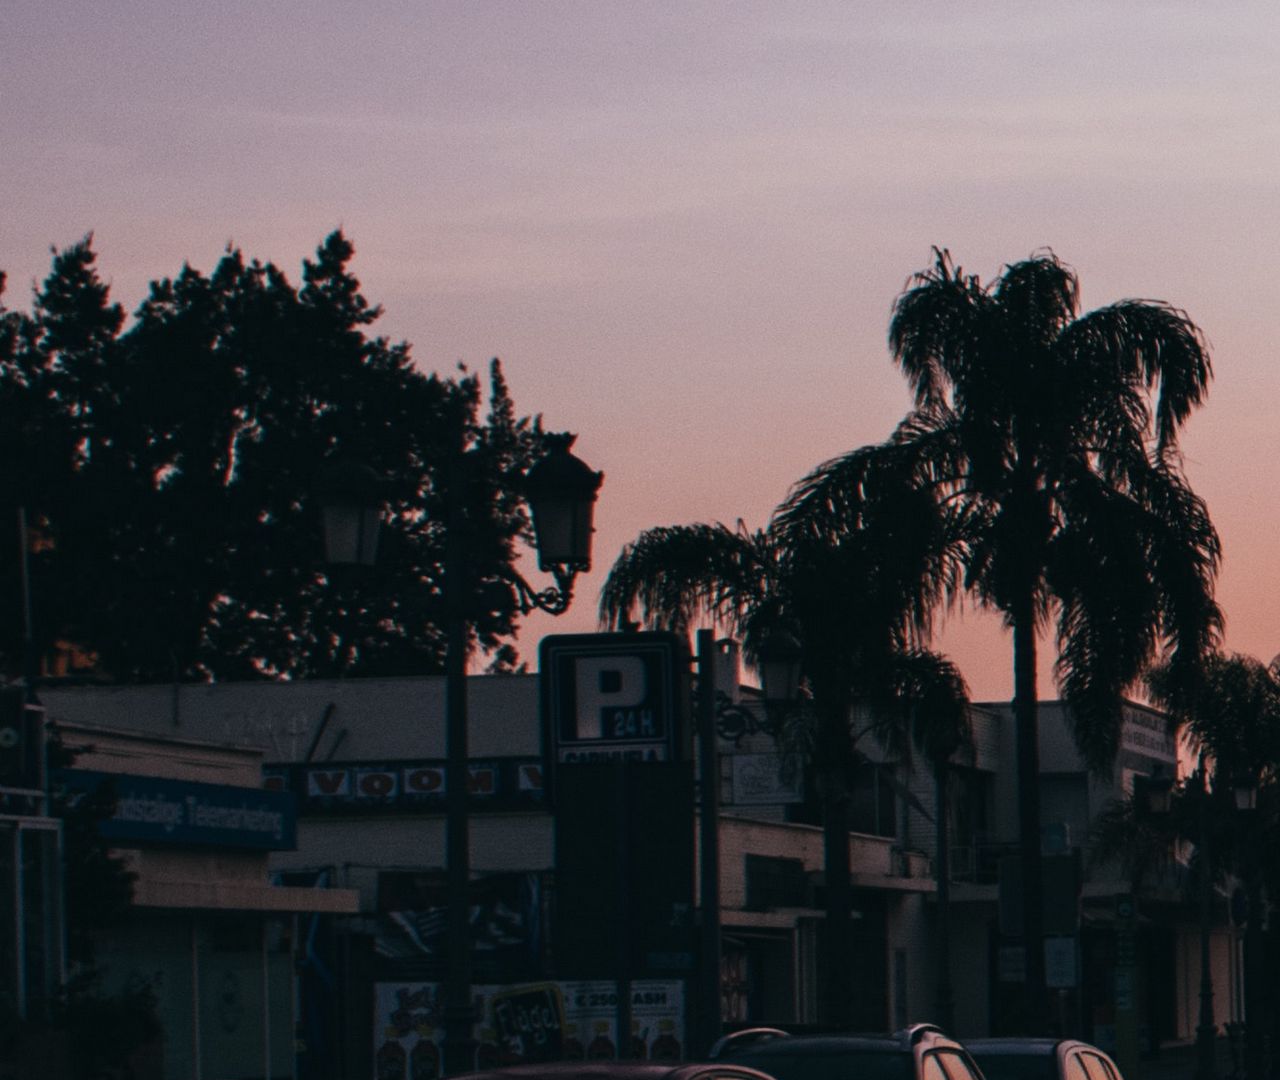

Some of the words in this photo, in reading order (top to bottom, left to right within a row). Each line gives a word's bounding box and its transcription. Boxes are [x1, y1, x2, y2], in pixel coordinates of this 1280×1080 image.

[576, 656, 647, 739] P
[613, 710, 636, 736] 24
[633, 993, 667, 1006] ASH
